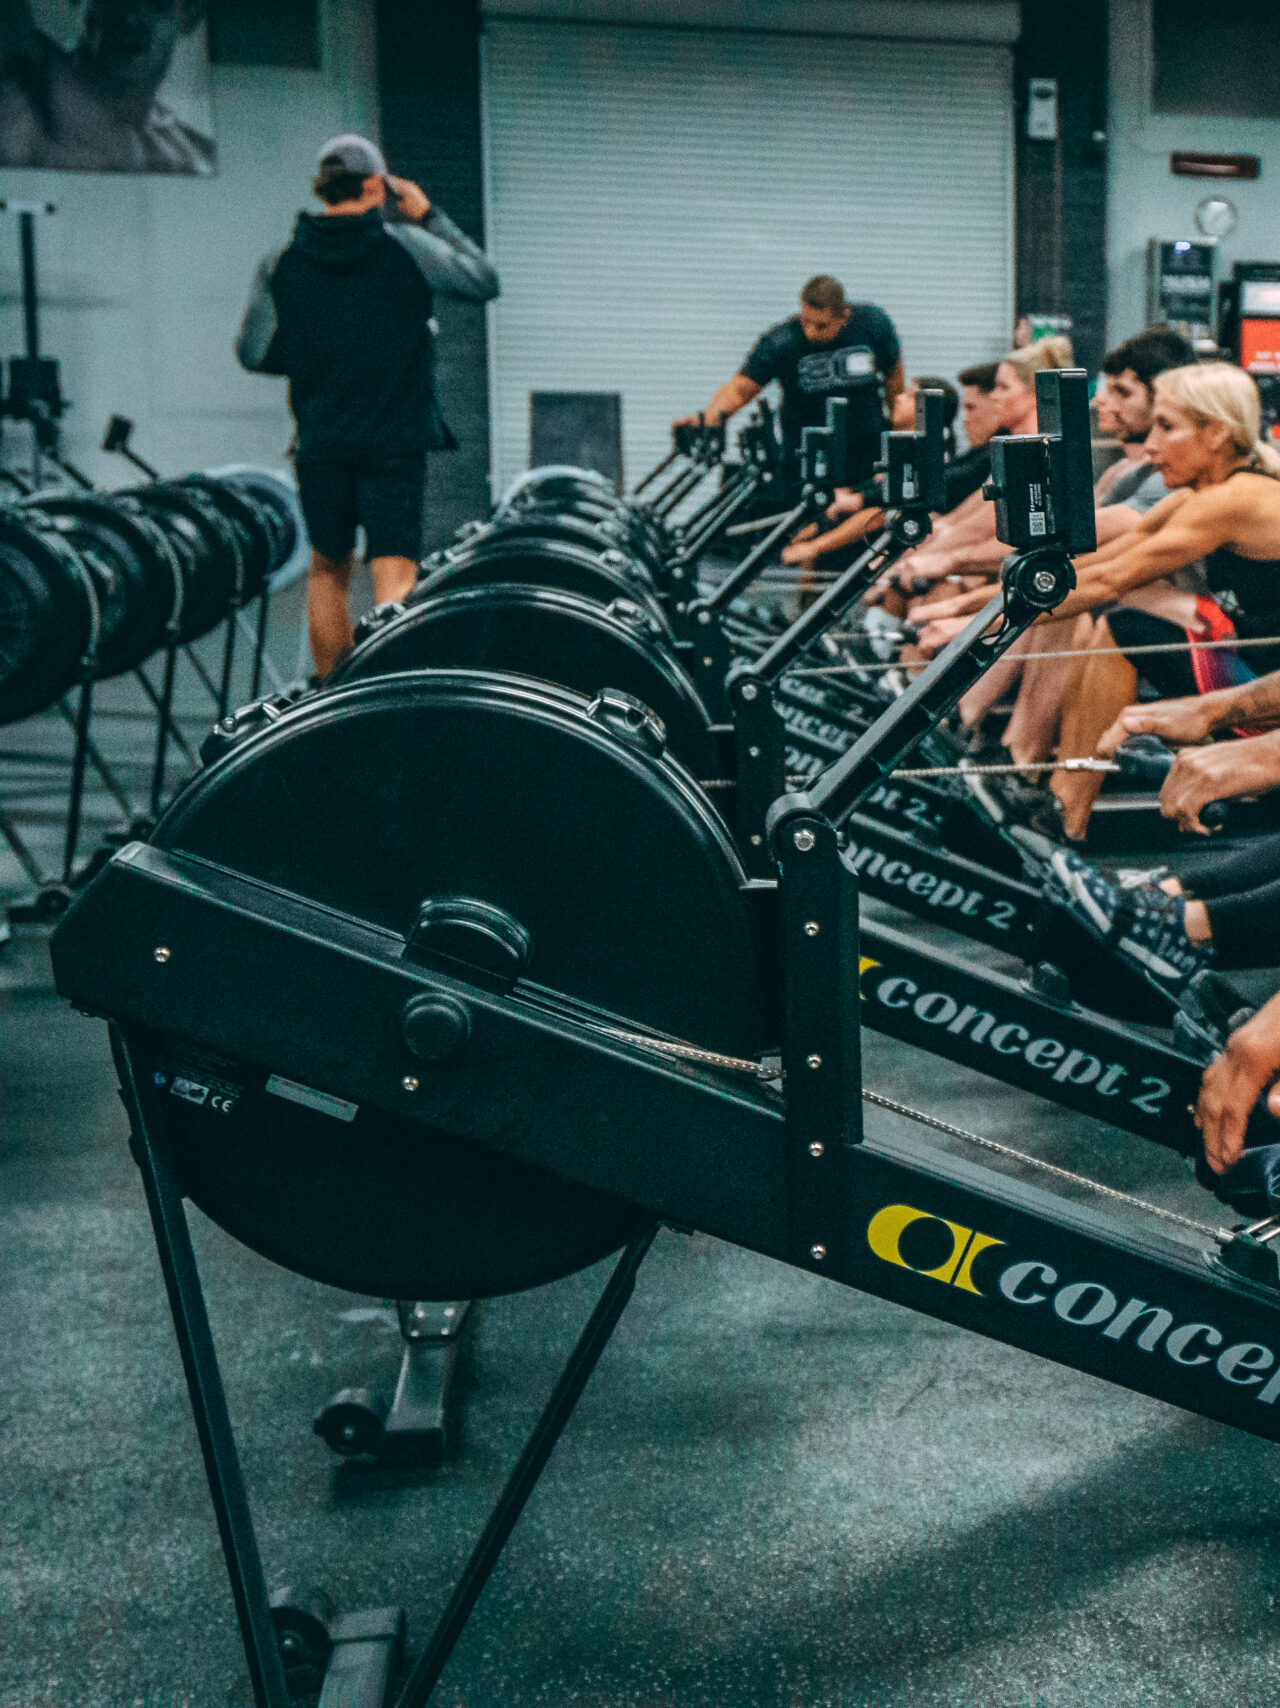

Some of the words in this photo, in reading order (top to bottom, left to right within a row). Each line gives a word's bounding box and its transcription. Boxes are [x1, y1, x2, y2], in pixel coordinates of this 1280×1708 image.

[844, 840, 984, 916] ncept
[986, 900, 1017, 931] 2
[876, 976, 1129, 1096] concept
[1131, 1076, 1171, 1114] 2
